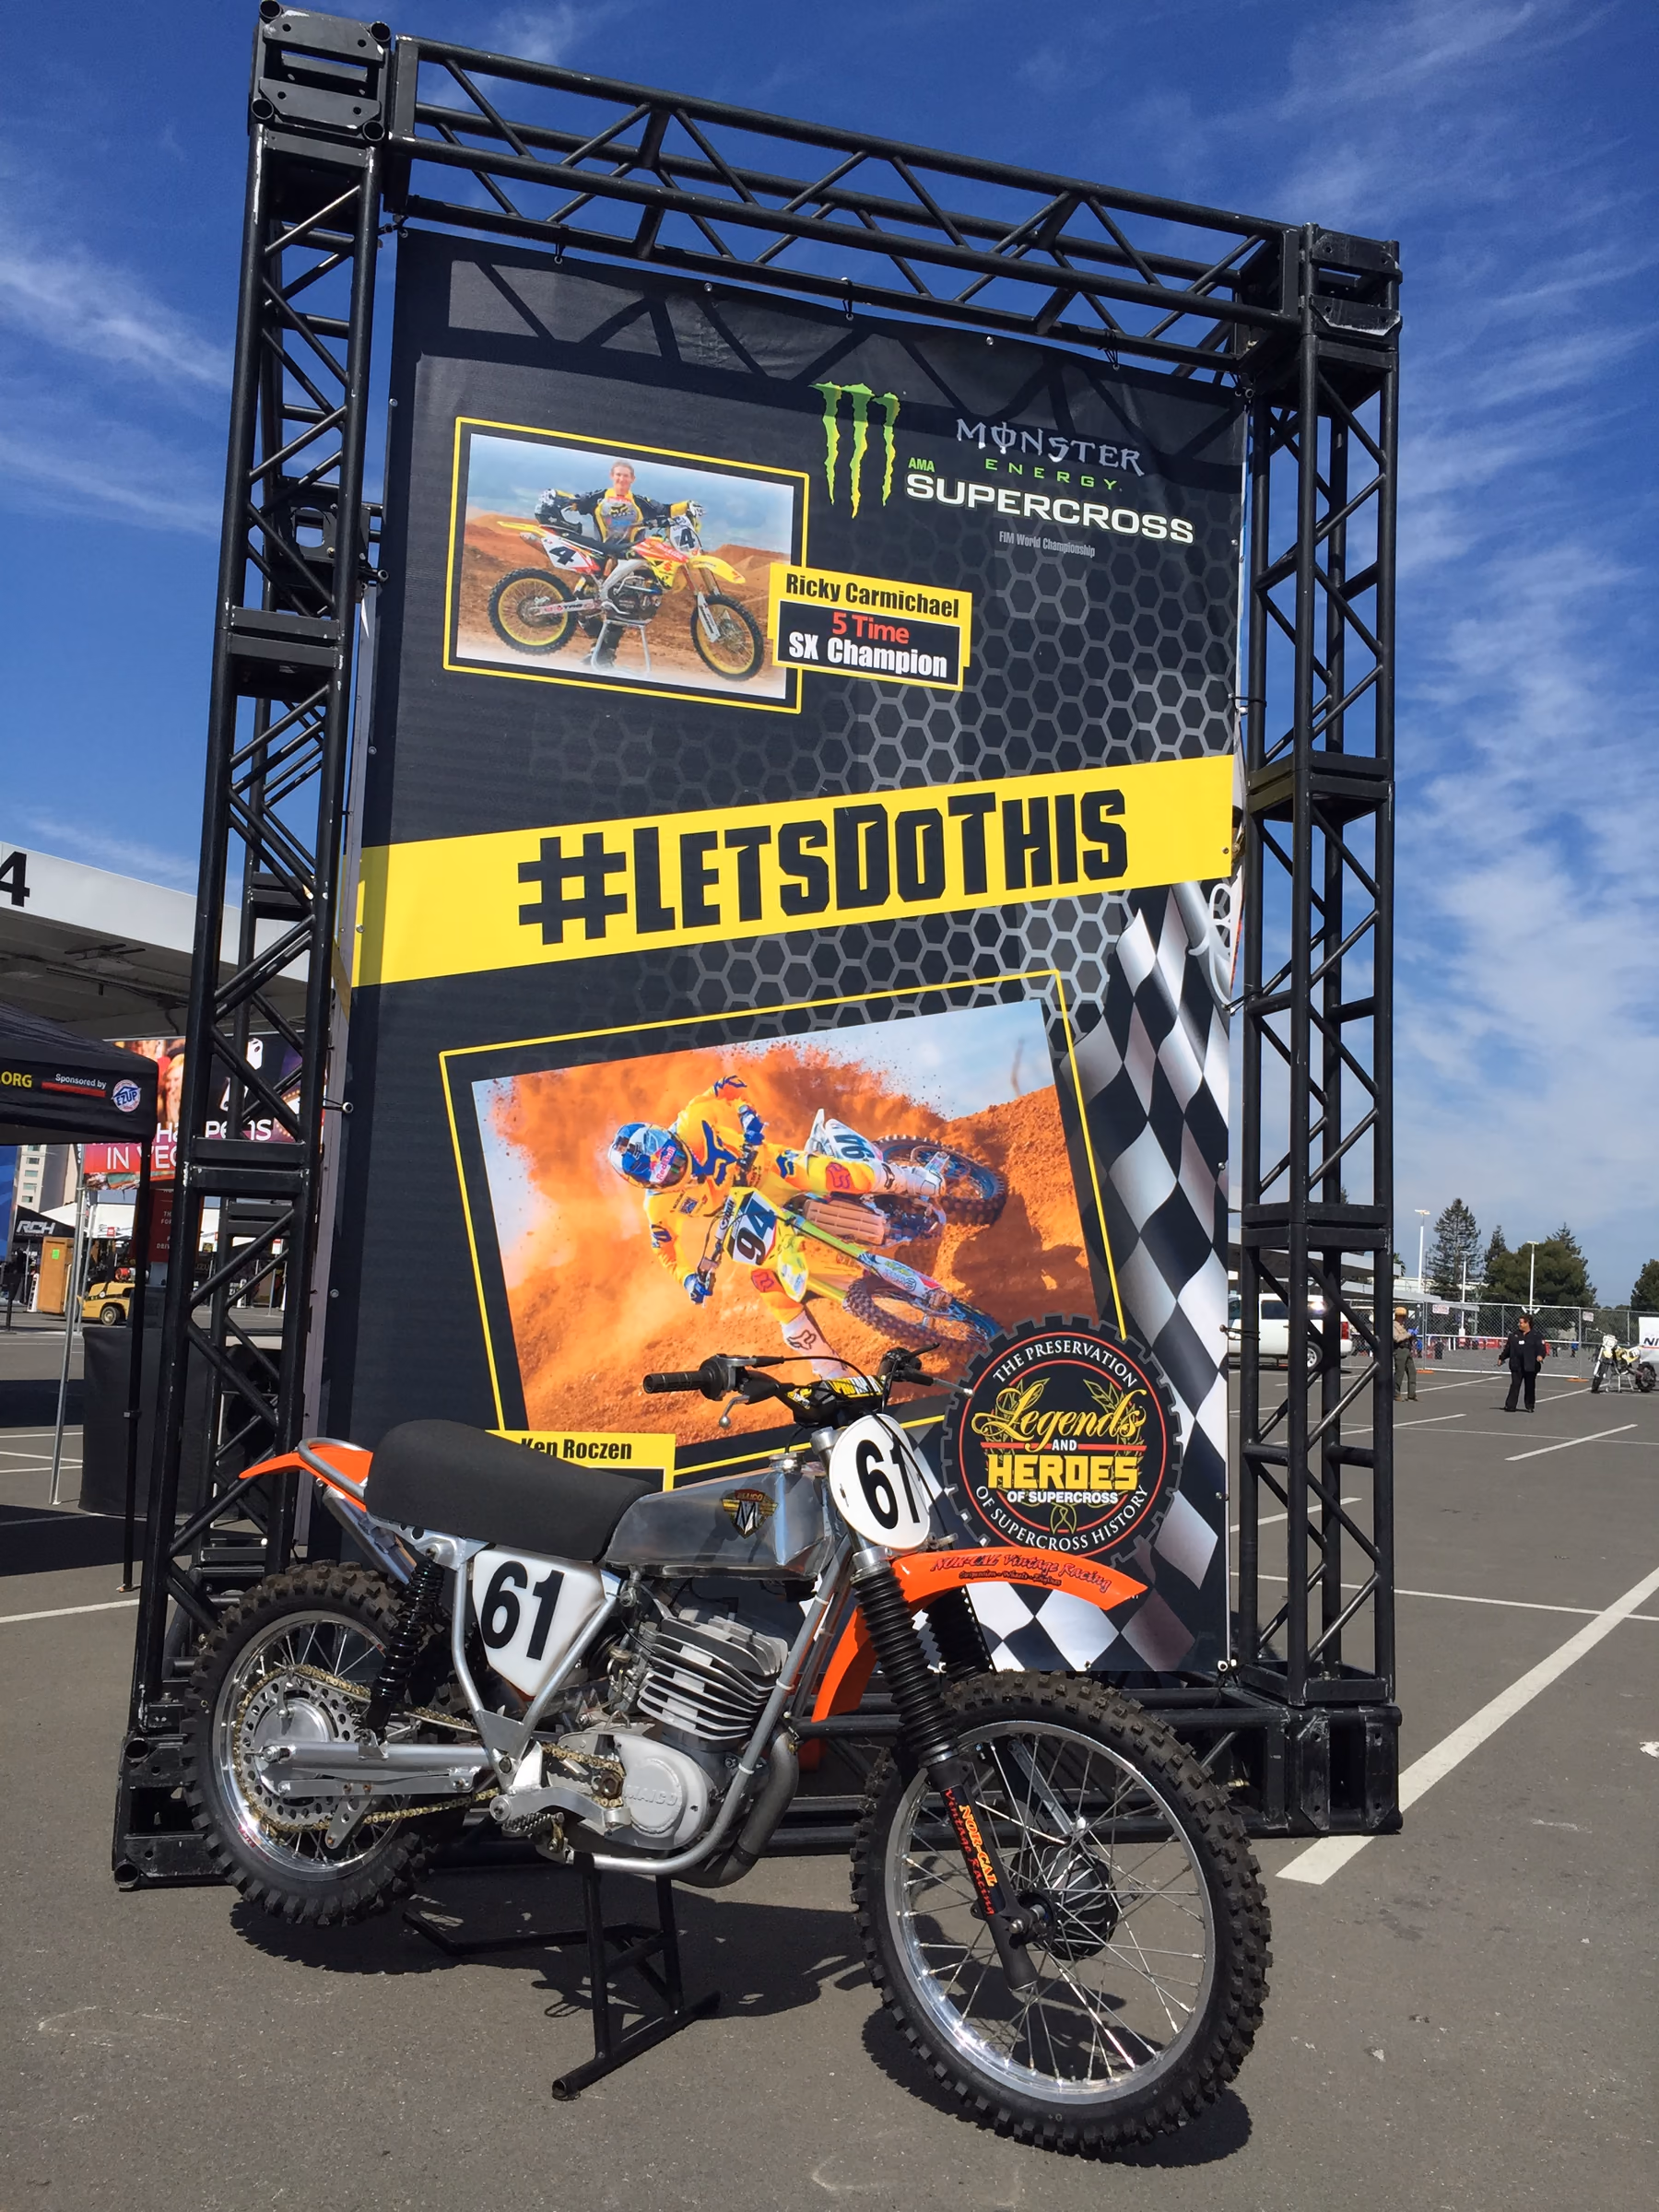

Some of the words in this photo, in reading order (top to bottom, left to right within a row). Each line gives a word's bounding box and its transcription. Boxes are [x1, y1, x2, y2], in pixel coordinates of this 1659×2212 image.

[908, 457, 935, 473] AMA
[956, 418, 1145, 477] MONSTER
[984, 458, 1117, 491] ENERGY
[906, 473, 1194, 544] SUPERCROSS
[549, 547, 576, 565] 4
[679, 528, 695, 548] 4
[999, 531, 1015, 544] FIM
[1017, 534, 1041, 548] World
[1042, 537, 1096, 558] Championship
[786, 573, 841, 602] Ricky
[845, 582, 959, 618] Carmichael
[832, 611, 848, 635] 5
[852, 614, 910, 644] Time
[789, 631, 818, 660] SX
[827, 637, 947, 678] Champion
[55, 1074, 96, 1088] Sponsored
[97, 1080, 107, 1090] by
[107, 1146, 130, 1170] IN
[16, 1220, 56, 1234] RCH
[736, 1198, 777, 1265] 94
[993, 1353, 1025, 1383] THE
[1025, 1339, 1137, 1388] PRESERVATION
[971, 1382, 1147, 1453] Legends
[562, 1438, 632, 1459] Roczen
[1052, 1439, 1077, 1452] AND
[855, 1435, 921, 1530] 61
[987, 1454, 1138, 1490] HEROES
[1006, 1490, 1025, 1503] OF
[1028, 1490, 1119, 1504] SUPERCROSS
[976, 1485, 995, 1509] OF
[990, 1507, 1088, 1552] SUPERCROSS
[1091, 1484, 1148, 1544] HISTORY
[1003, 1553, 1060, 1574] Vintage
[1058, 1562, 1112, 1594] Racing
[480, 1560, 565, 1661] 61
[959, 1805, 997, 1887] NOR-CAL
